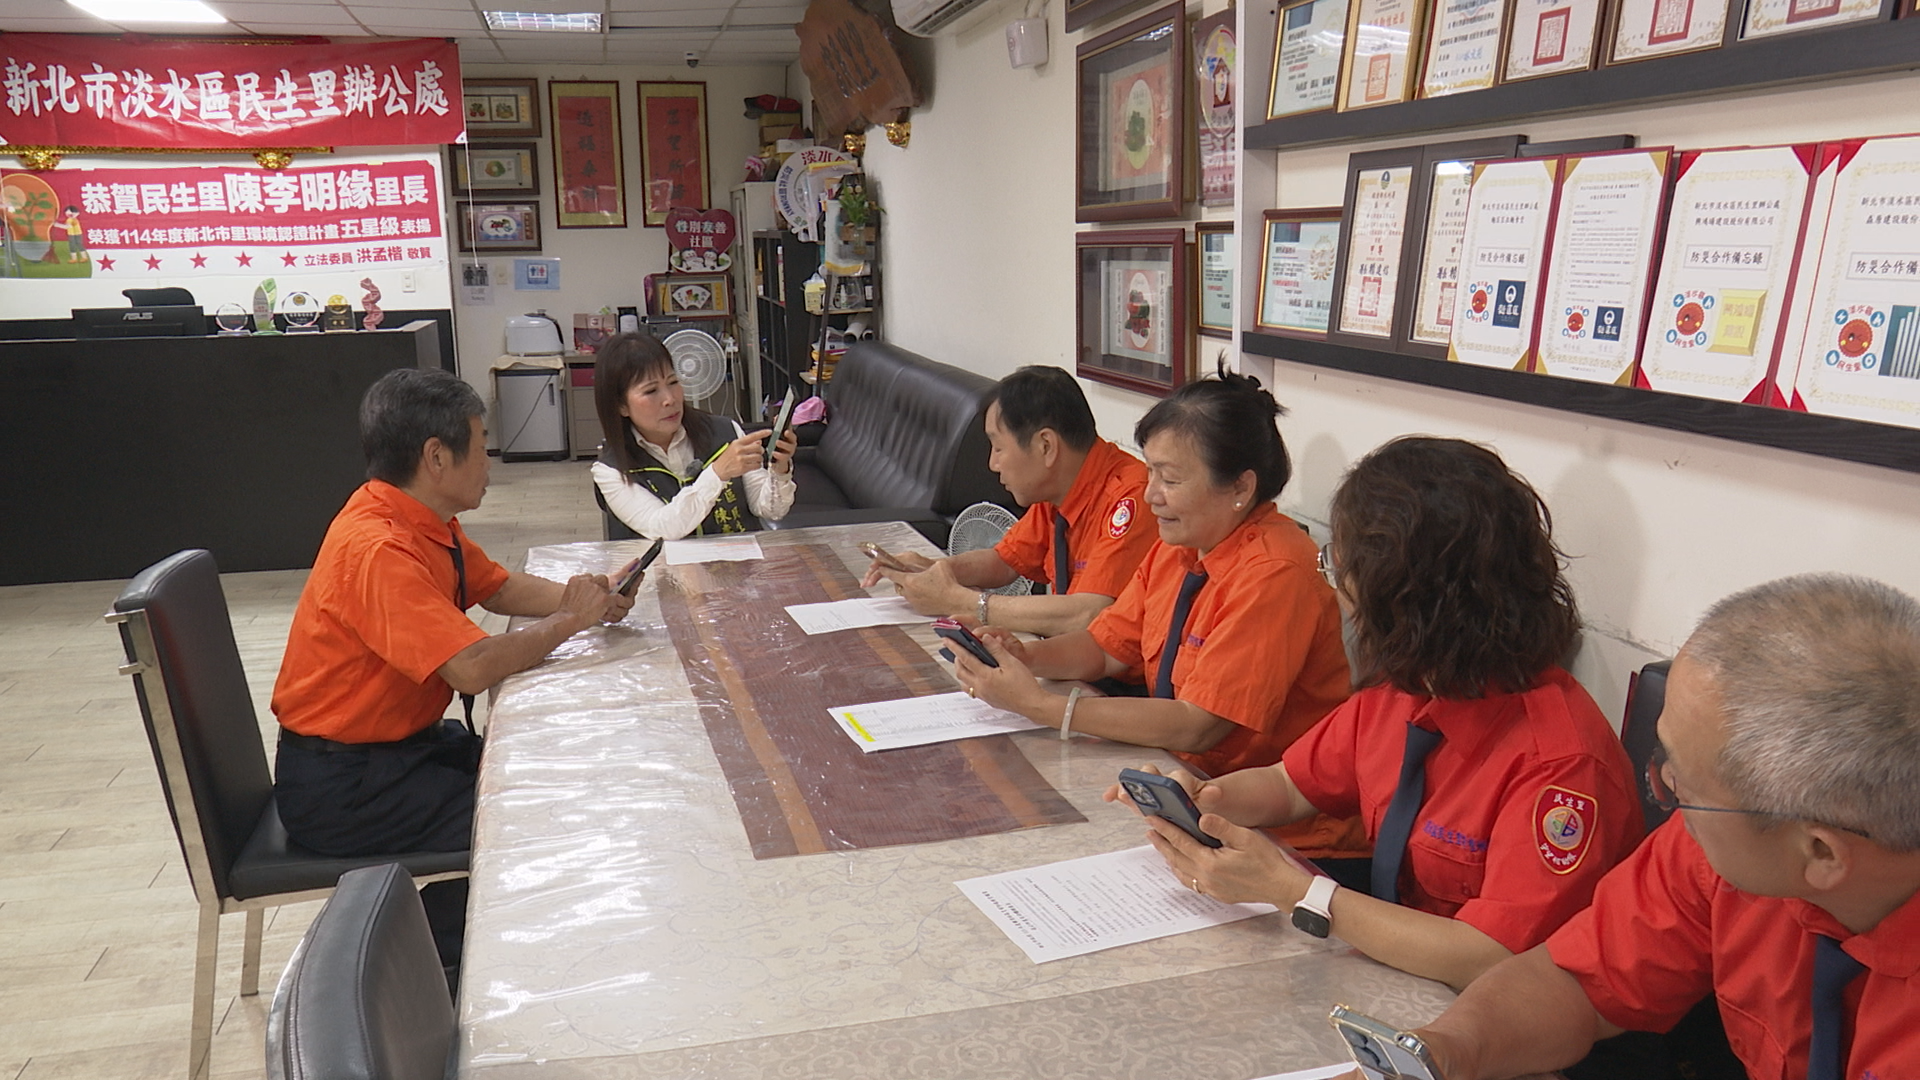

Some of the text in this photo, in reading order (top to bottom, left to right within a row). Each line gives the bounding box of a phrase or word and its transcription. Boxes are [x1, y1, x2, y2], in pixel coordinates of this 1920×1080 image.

[2, 56, 450, 121] 新北市淡水區民生里辦公處
[81, 170, 429, 215] 恭賀民生里陳李明緣里長
[1695, 200, 1780, 210] 新北市淡水區民生里辦公處
[87, 217, 432, 245] 榮獲114年度新北市里環境認證計畫五星級表揚
[675, 220, 727, 234] 性別友善
[689, 235, 714, 248] 社區
[304, 246, 432, 266] 立法委員 洪孟楷 敬賀
[1480, 252, 1525, 264] 防災合作備忘錄
[1690, 250, 1763, 264] 防災合作備忘錄
[1855, 259, 1918, 275] 防災合作備
[122, 312, 153, 321] ASUS
[1553, 793, 1586, 811] 民生里
